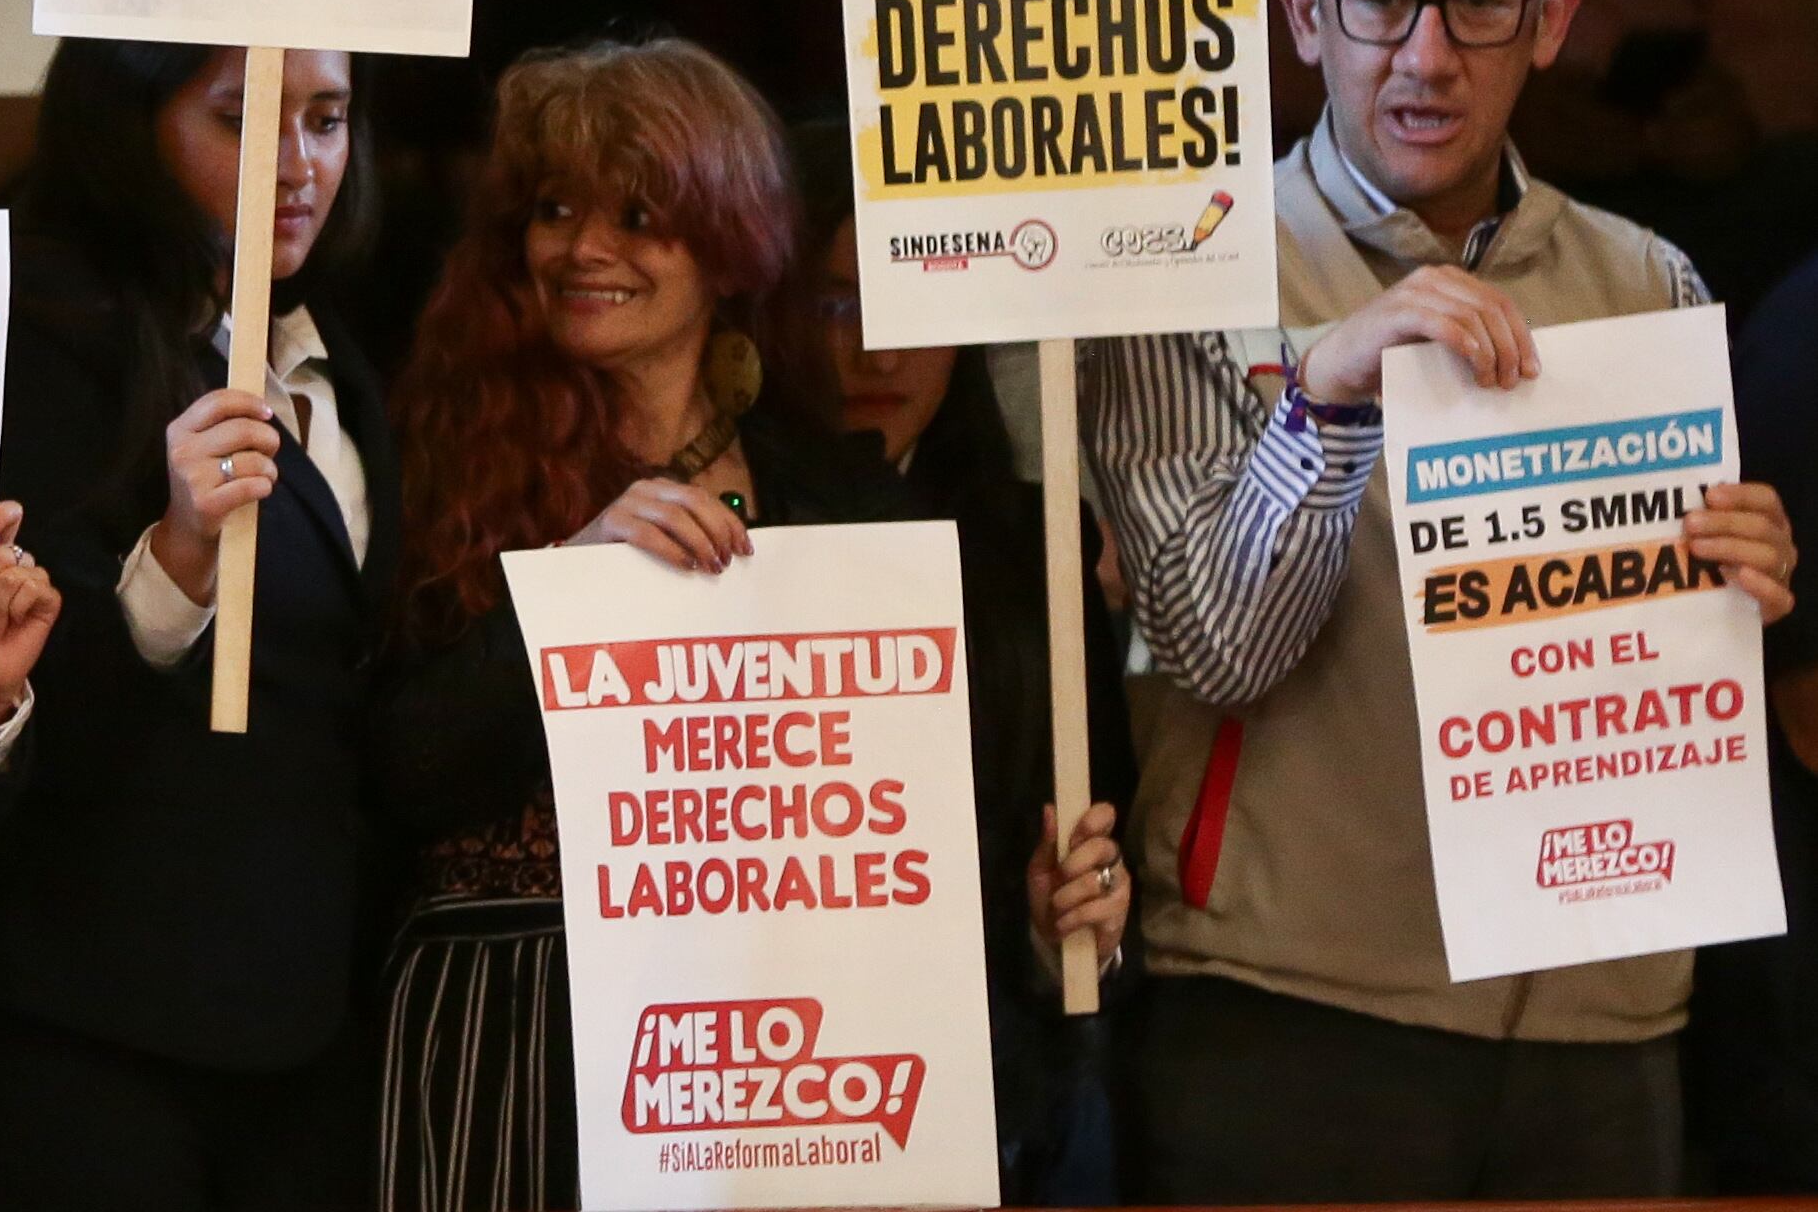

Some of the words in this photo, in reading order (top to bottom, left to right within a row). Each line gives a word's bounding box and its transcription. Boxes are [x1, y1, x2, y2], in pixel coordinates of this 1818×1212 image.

[880, 84, 1240, 186] LABORALES!
[890, 230, 1005, 258] SINDESENA
[1415, 420, 1715, 492] MONETIZACIÓN
[1410, 515, 1468, 554] DE
[1484, 505, 1545, 543] 1.5
[1561, 483, 1722, 532] SMML
[1424, 570, 1491, 624] ES
[548, 650, 631, 707] LA
[644, 635, 943, 702] JUVENTUD
[1511, 638, 1594, 677] CON
[1611, 631, 1659, 664] EL
[643, 710, 853, 772] MERECE
[1438, 678, 1745, 759] CONTRATO
[1450, 770, 1494, 801] DE
[1506, 735, 1748, 794] APRENDIZAJE
[608, 779, 906, 847] DERECHOS
[1543, 828, 1587, 858] ¡ME
[1592, 822, 1627, 852] LO
[596, 849, 932, 920] LABORALES
[1542, 843, 1670, 885] MEREZCO!
[637, 1010, 718, 1068] ¡ME
[732, 1006, 806, 1061] LO
[633, 1060, 913, 1127] MEREZCO!
[659, 1131, 881, 1173] #SiALaReformaLaboral
